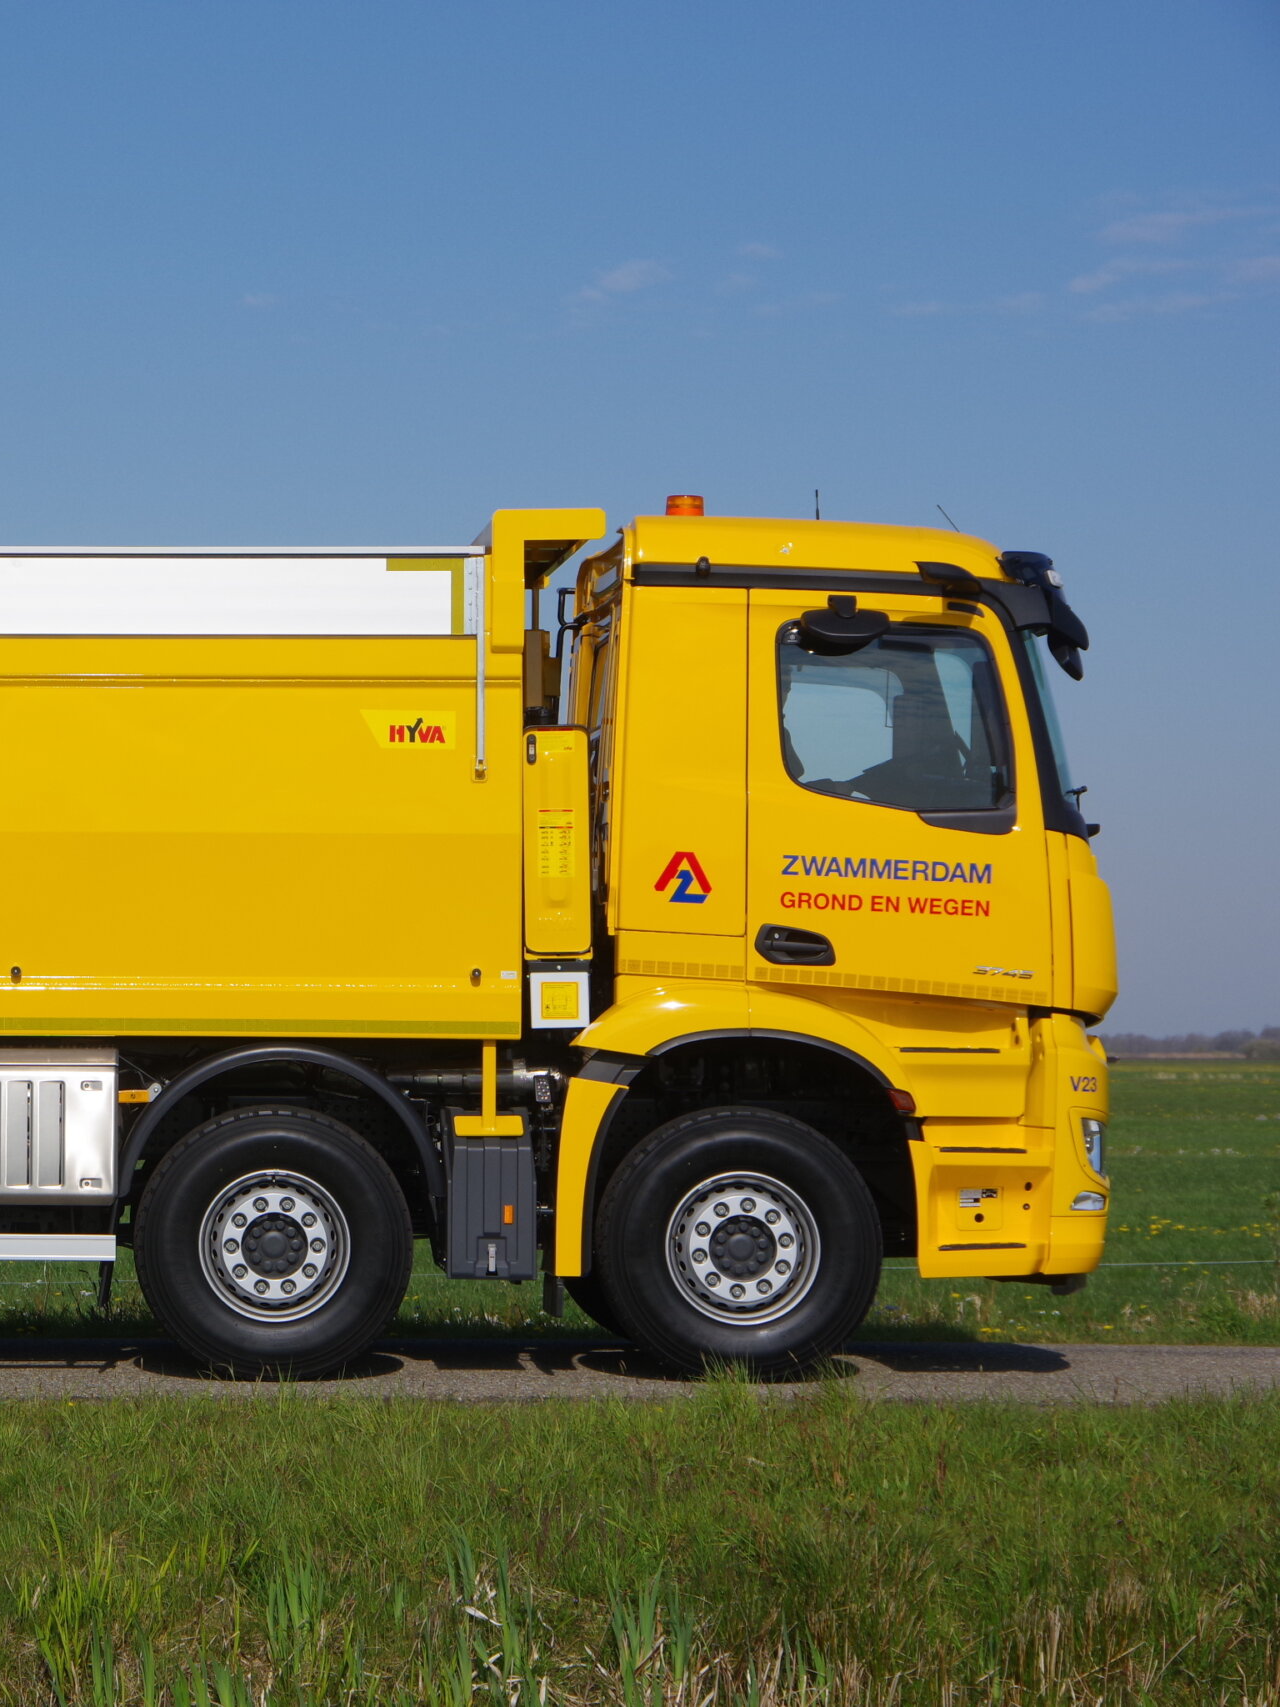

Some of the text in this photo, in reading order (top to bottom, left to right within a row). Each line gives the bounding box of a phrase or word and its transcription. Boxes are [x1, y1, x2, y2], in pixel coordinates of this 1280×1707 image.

[389, 717, 446, 744] HYVA
[781, 854, 993, 884] ZWAMMERDAM
[780, 891, 991, 917] GROND EN WEGEN
[1069, 1076, 1098, 1093] V23
